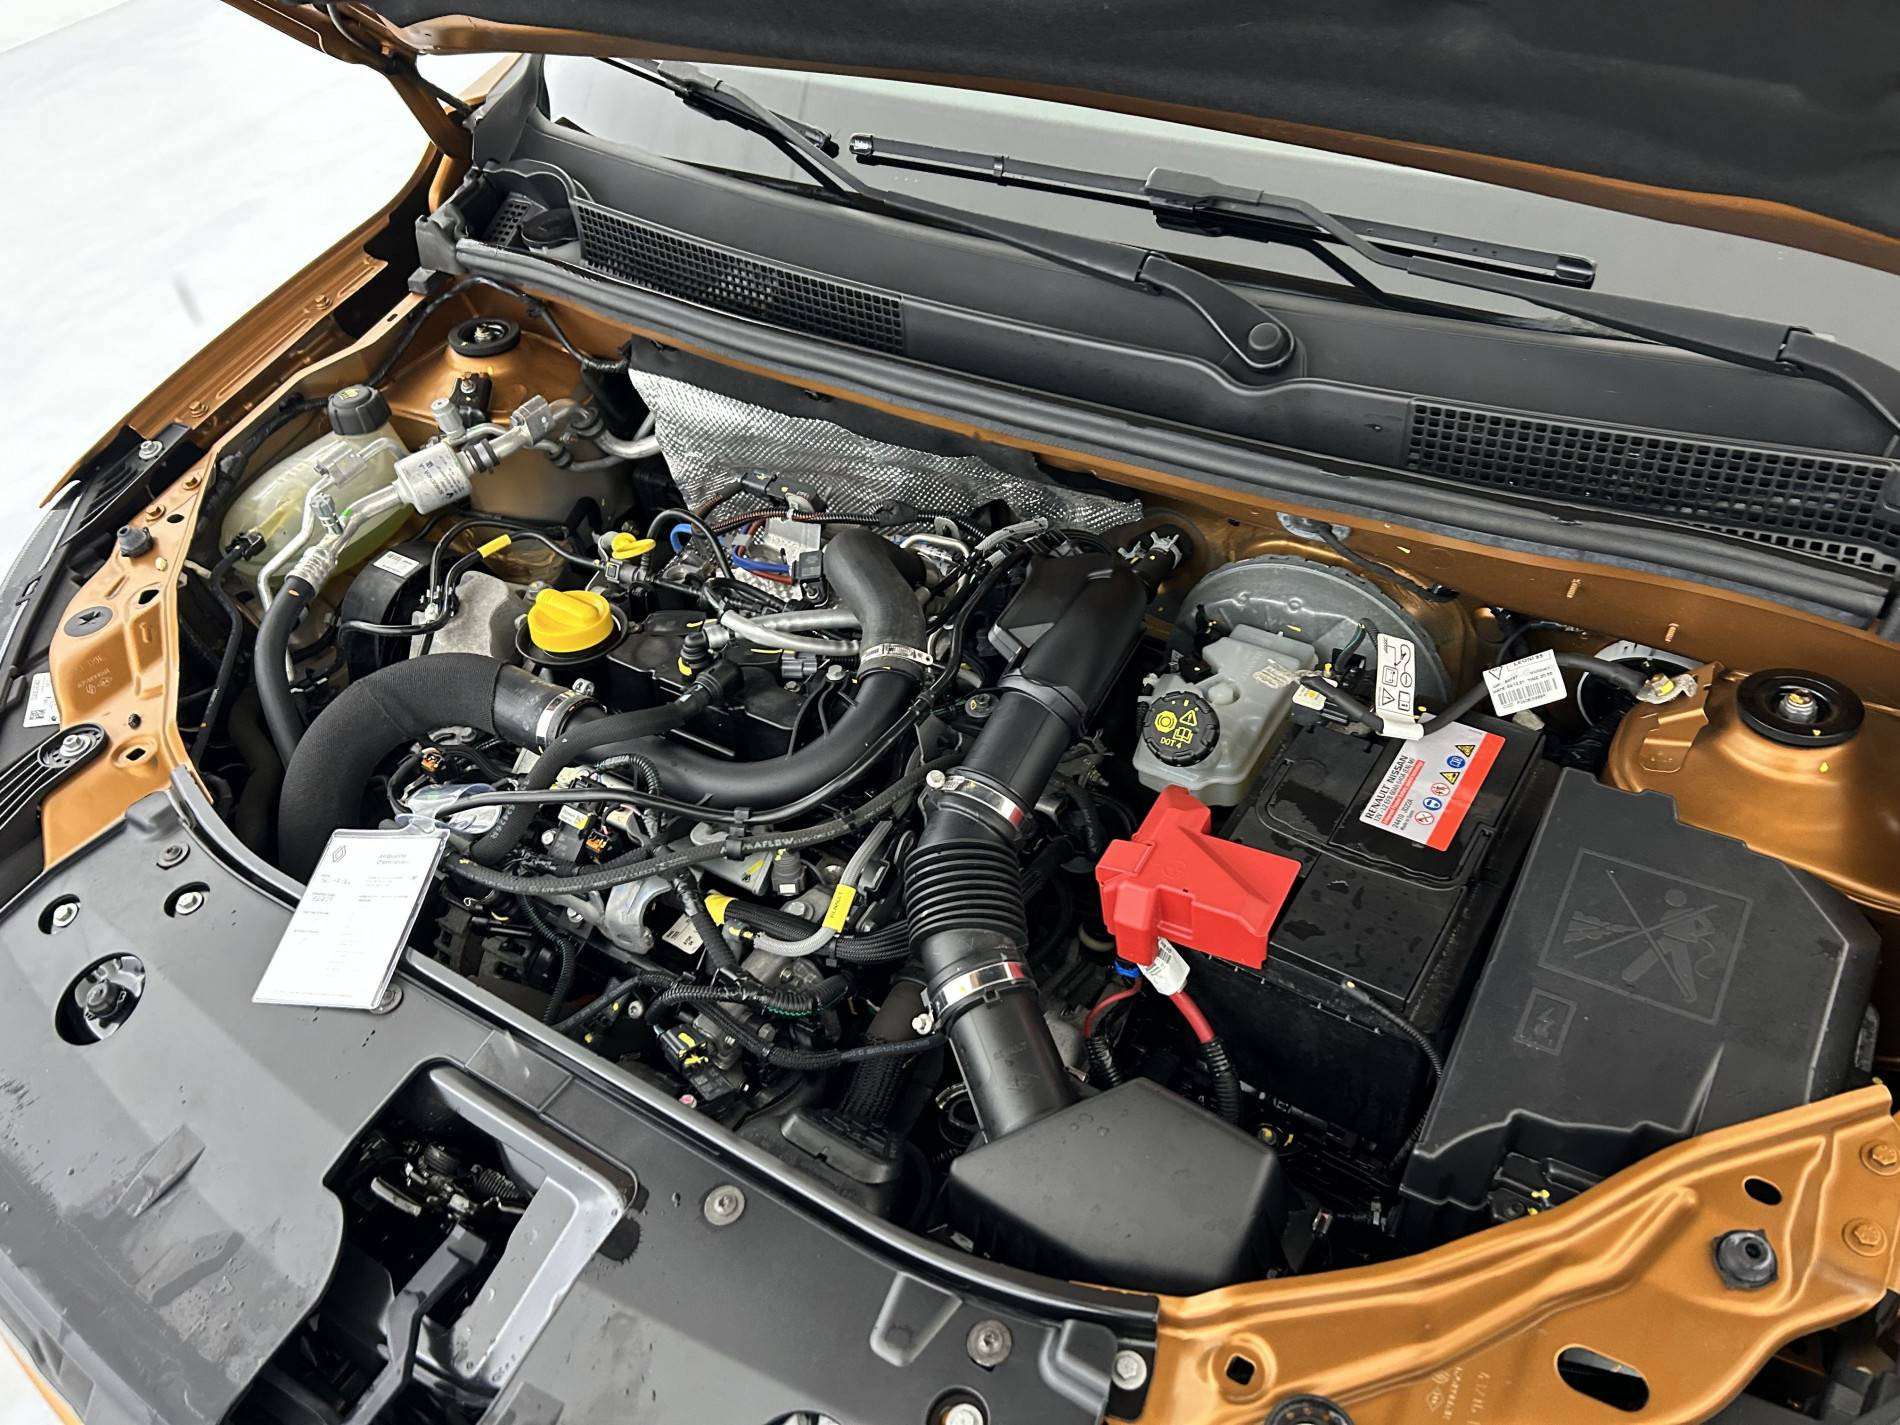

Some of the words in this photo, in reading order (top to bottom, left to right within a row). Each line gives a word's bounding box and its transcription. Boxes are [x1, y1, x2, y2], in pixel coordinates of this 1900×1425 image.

[1160, 736, 1176, 747] DOT
[1365, 783, 1390, 819] RENAULT
[1387, 755, 1408, 784] NISSAN
